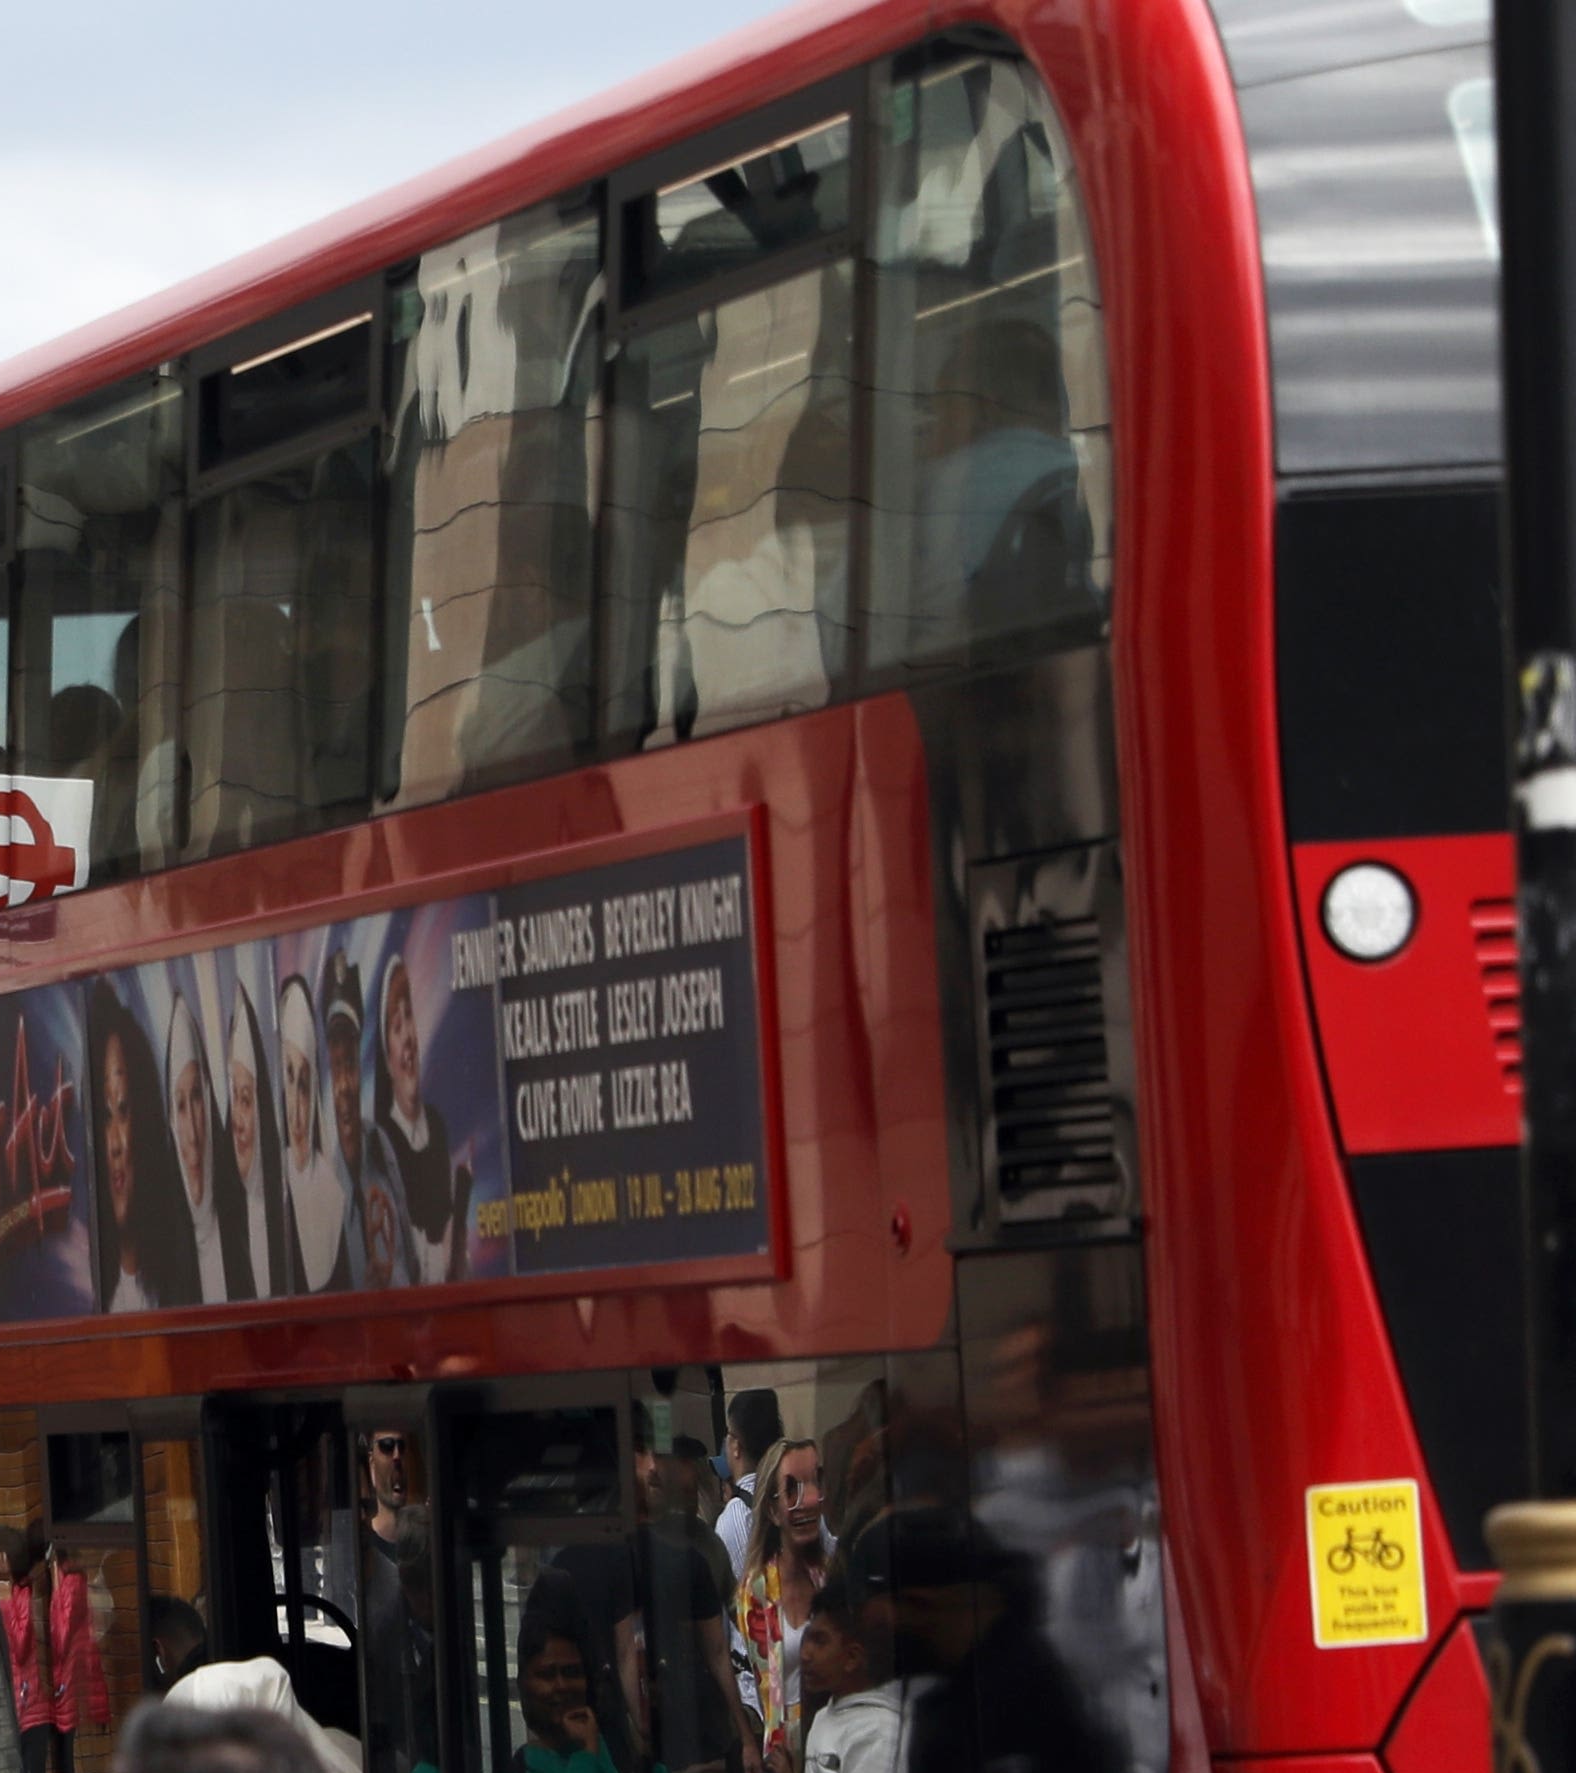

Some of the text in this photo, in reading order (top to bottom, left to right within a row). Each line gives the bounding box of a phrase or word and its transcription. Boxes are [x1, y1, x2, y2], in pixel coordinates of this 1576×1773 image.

[450, 874, 743, 990] JENNIER SAUNDERS BEVERLEY KNIGHT
[503, 967, 725, 1060] KEALA SETTLE LESLEY JOSEPH
[516, 1060, 694, 1142] CLIVE ROWE LIZZIE BEA
[572, 1177, 617, 1225] LONDON
[626, 1173, 642, 1219] 19
[643, 1173, 664, 1218] JUL
[695, 1166, 721, 1212] AUG
[723, 1163, 755, 1210] 2022
[1318, 1496, 1407, 1517] Caution
[1340, 1586, 1368, 1597] This
